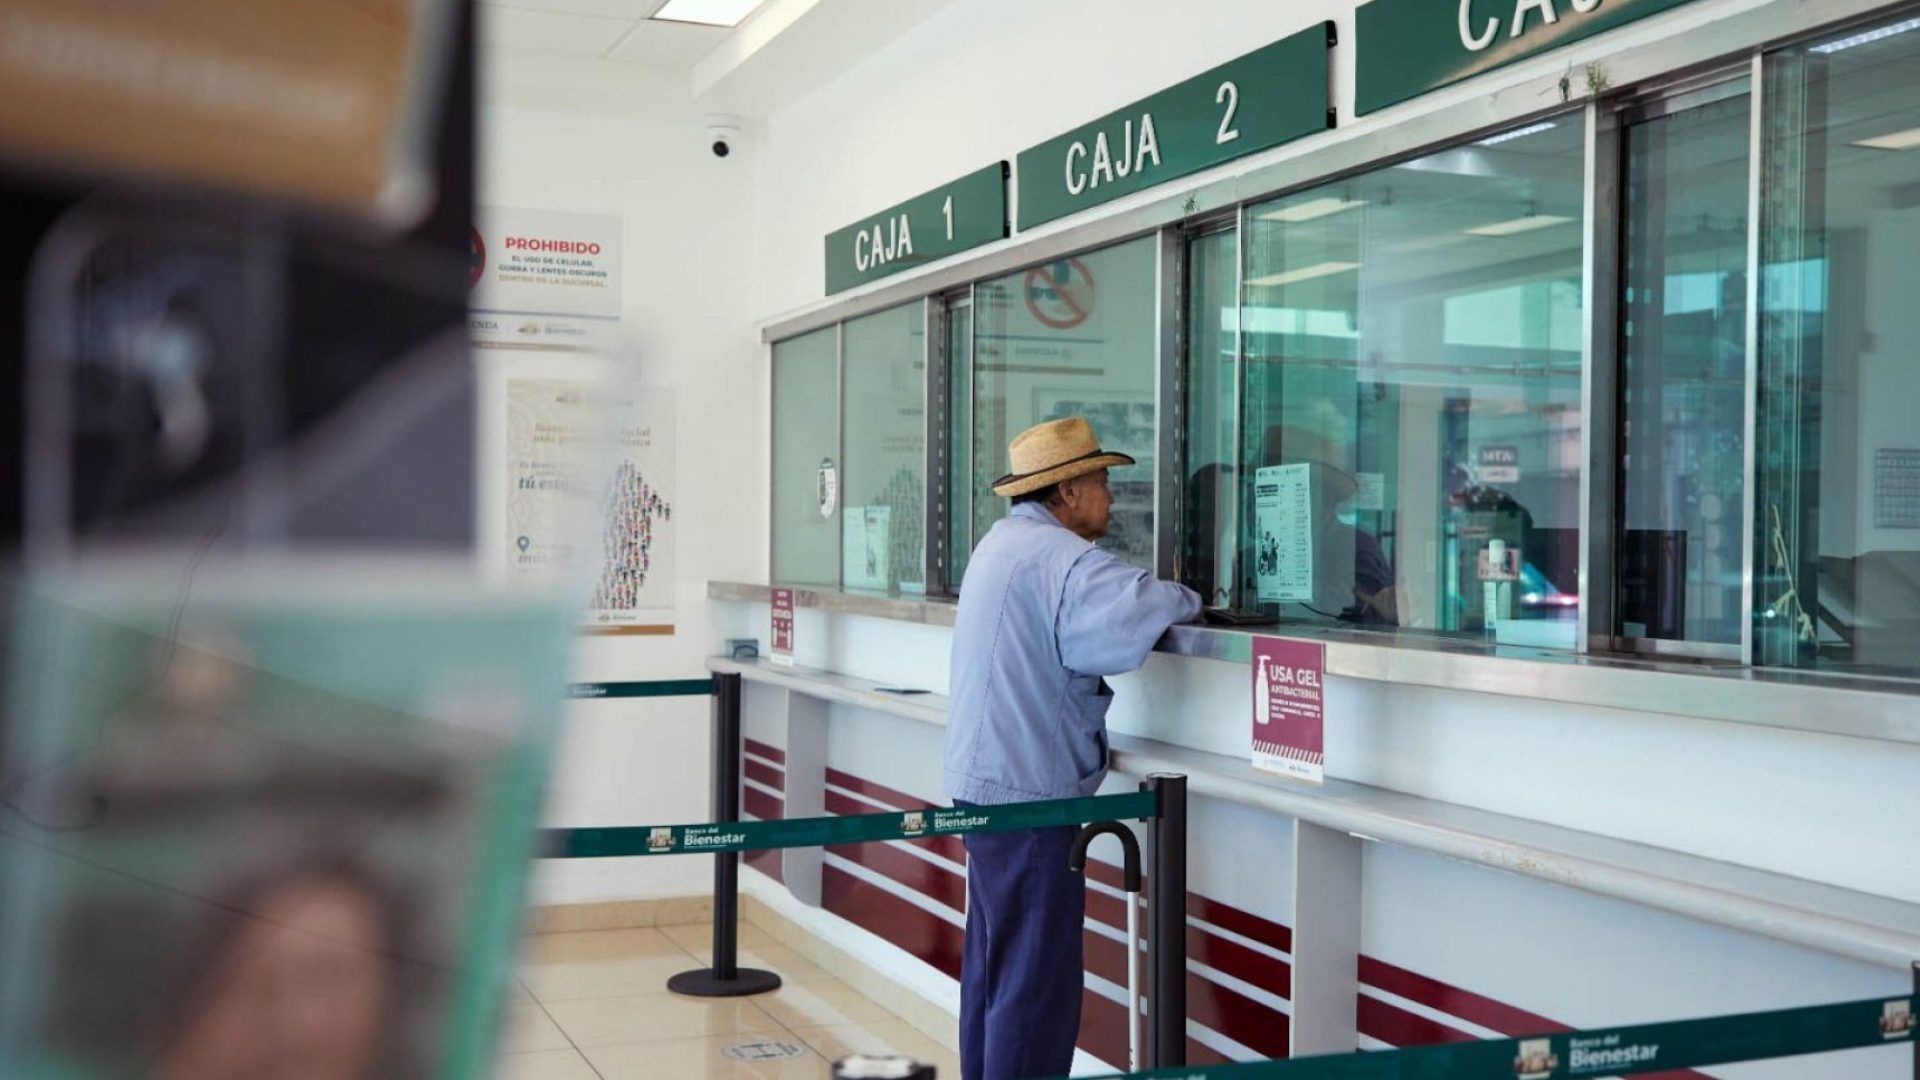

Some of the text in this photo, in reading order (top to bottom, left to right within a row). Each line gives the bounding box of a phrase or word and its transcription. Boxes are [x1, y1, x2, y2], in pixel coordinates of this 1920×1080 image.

[1065, 80, 1240, 196] CAJA 2
[855, 195, 953, 272] CAJA 1
[505, 237, 601, 255] PROHIBIDO
[542, 257, 554, 265] DE
[498, 264, 527, 272] GORRA
[537, 266, 566, 275] LENTES
[569, 268, 608, 278] OSCUROS
[550, 277, 560, 285] LA
[1270, 664, 1320, 688] USA GEL
[1271, 684, 1320, 701] ANTIBACTERIAL
[934, 816, 989, 828] Bienestar
[708, 826, 719, 834] del
[684, 833, 746, 846] Bienestar
[1569, 1034, 1620, 1048] Banco del
[1569, 1044, 1659, 1067] Bienestar
